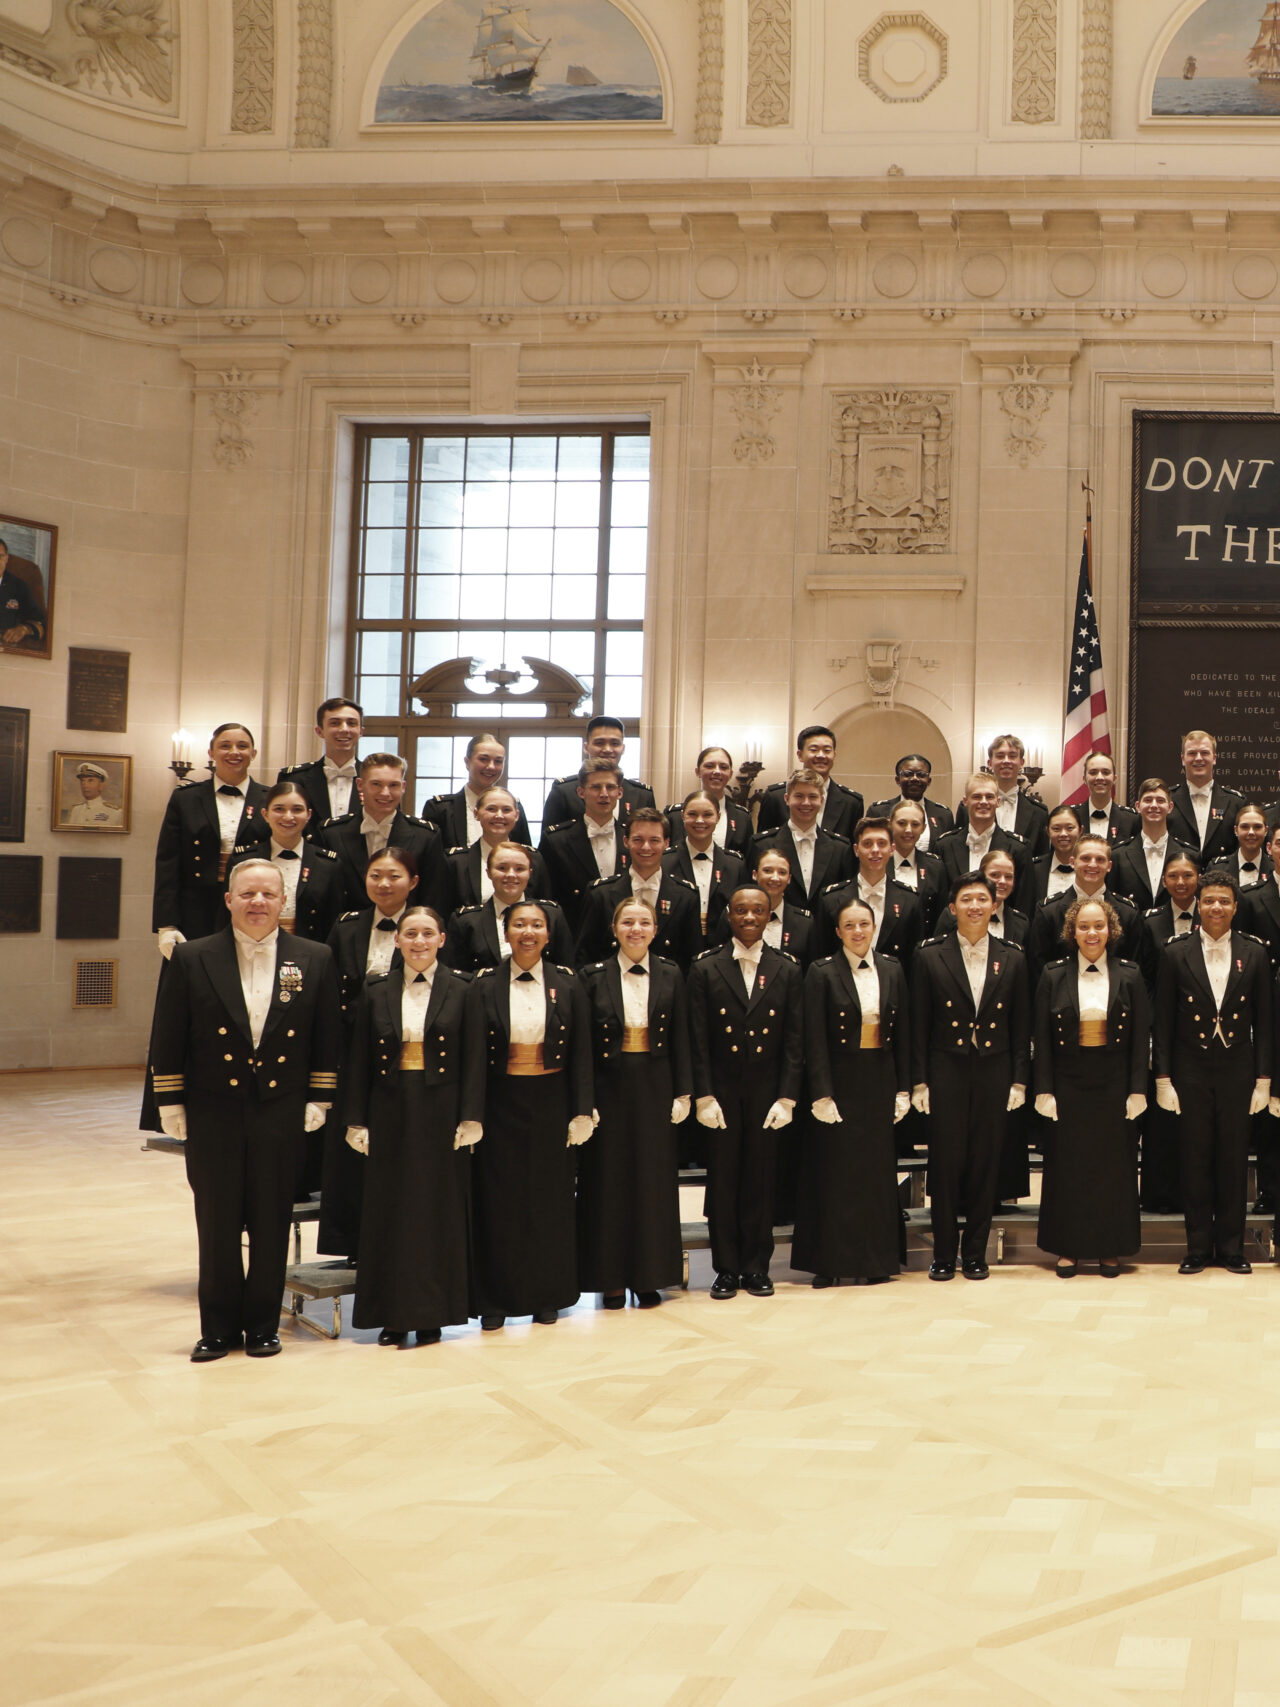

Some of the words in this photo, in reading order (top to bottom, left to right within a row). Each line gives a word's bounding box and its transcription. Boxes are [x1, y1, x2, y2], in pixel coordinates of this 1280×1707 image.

[1144, 456, 1275, 493] DONT
[1190, 673, 1239, 681] DEDICATED
[1261, 674, 1277, 682] THE
[1221, 706, 1238, 714] THE
[1238, 768, 1276, 776] LOYALTY
